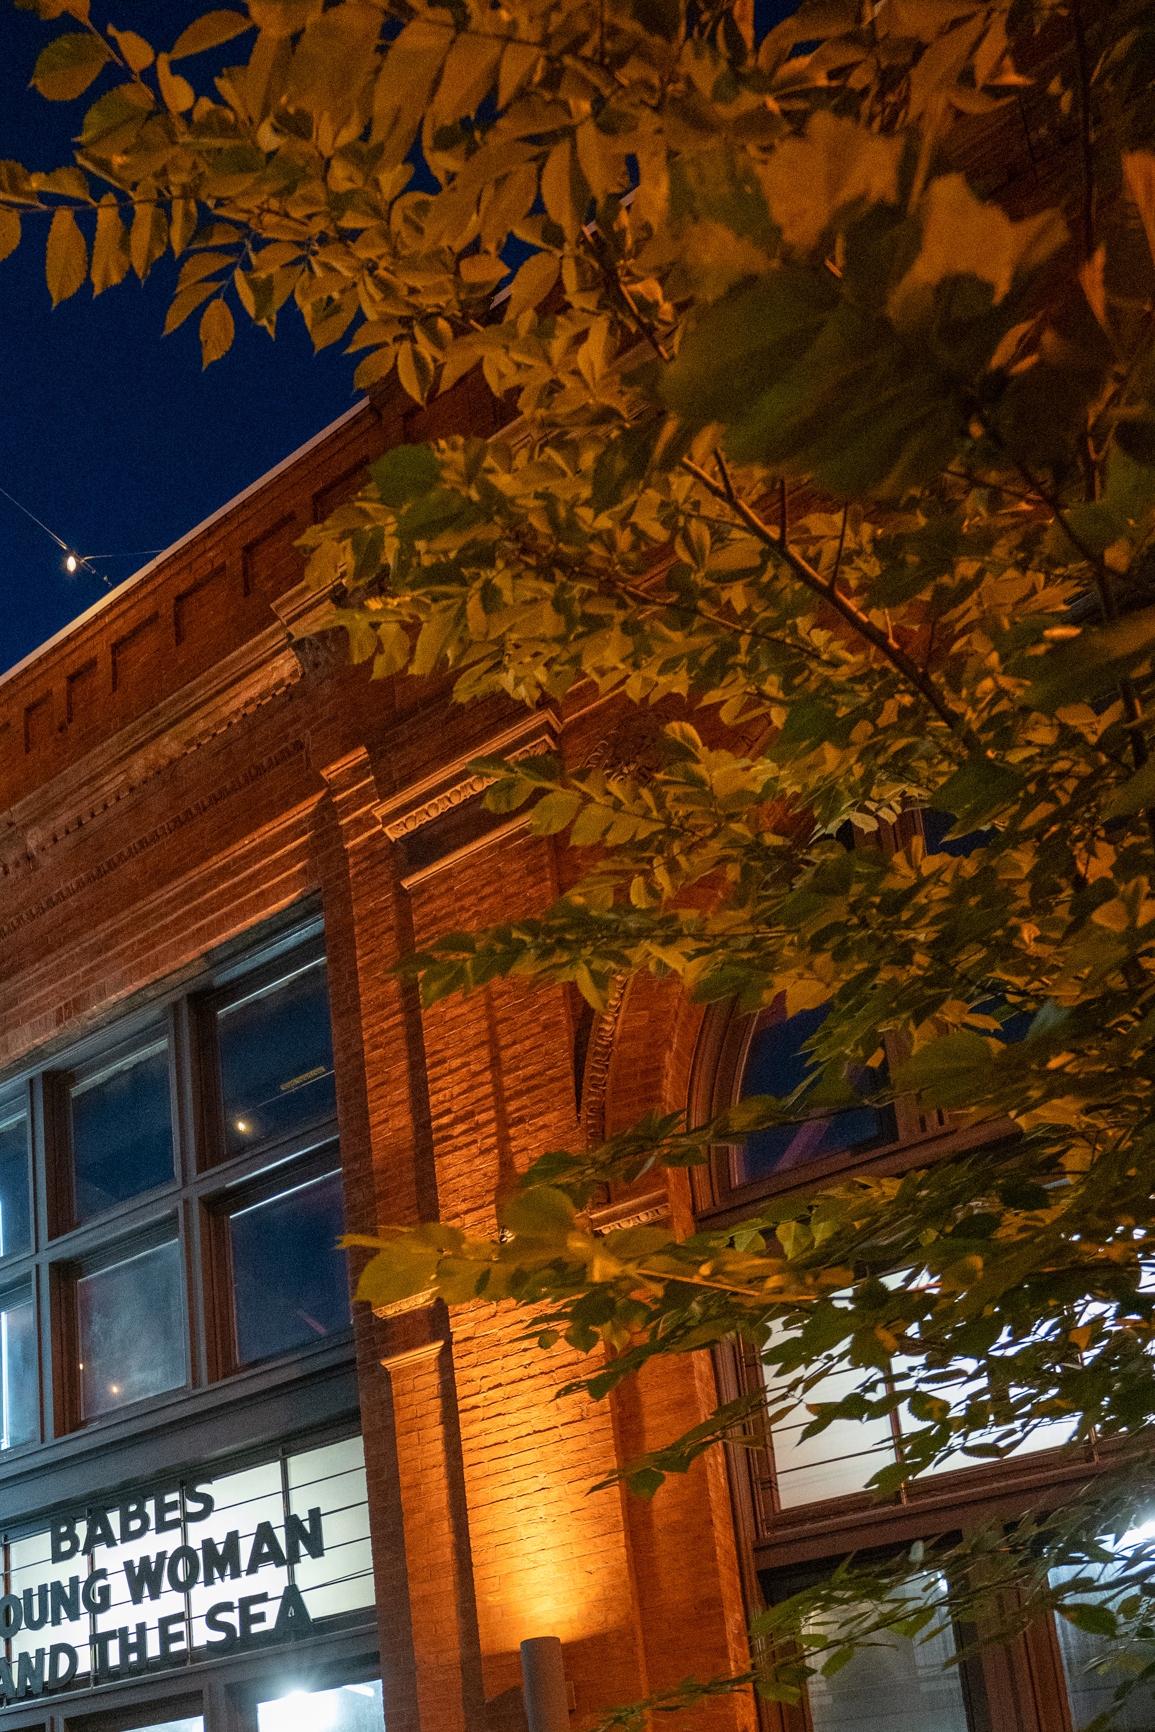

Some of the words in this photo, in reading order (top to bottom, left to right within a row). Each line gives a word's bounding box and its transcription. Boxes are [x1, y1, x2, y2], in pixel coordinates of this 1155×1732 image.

[49, 1481, 216, 1565] BABES
[122, 1506, 326, 1605] WOMAN
[88, 1611, 186, 1676] THE
[204, 1583, 314, 1654] SEA
